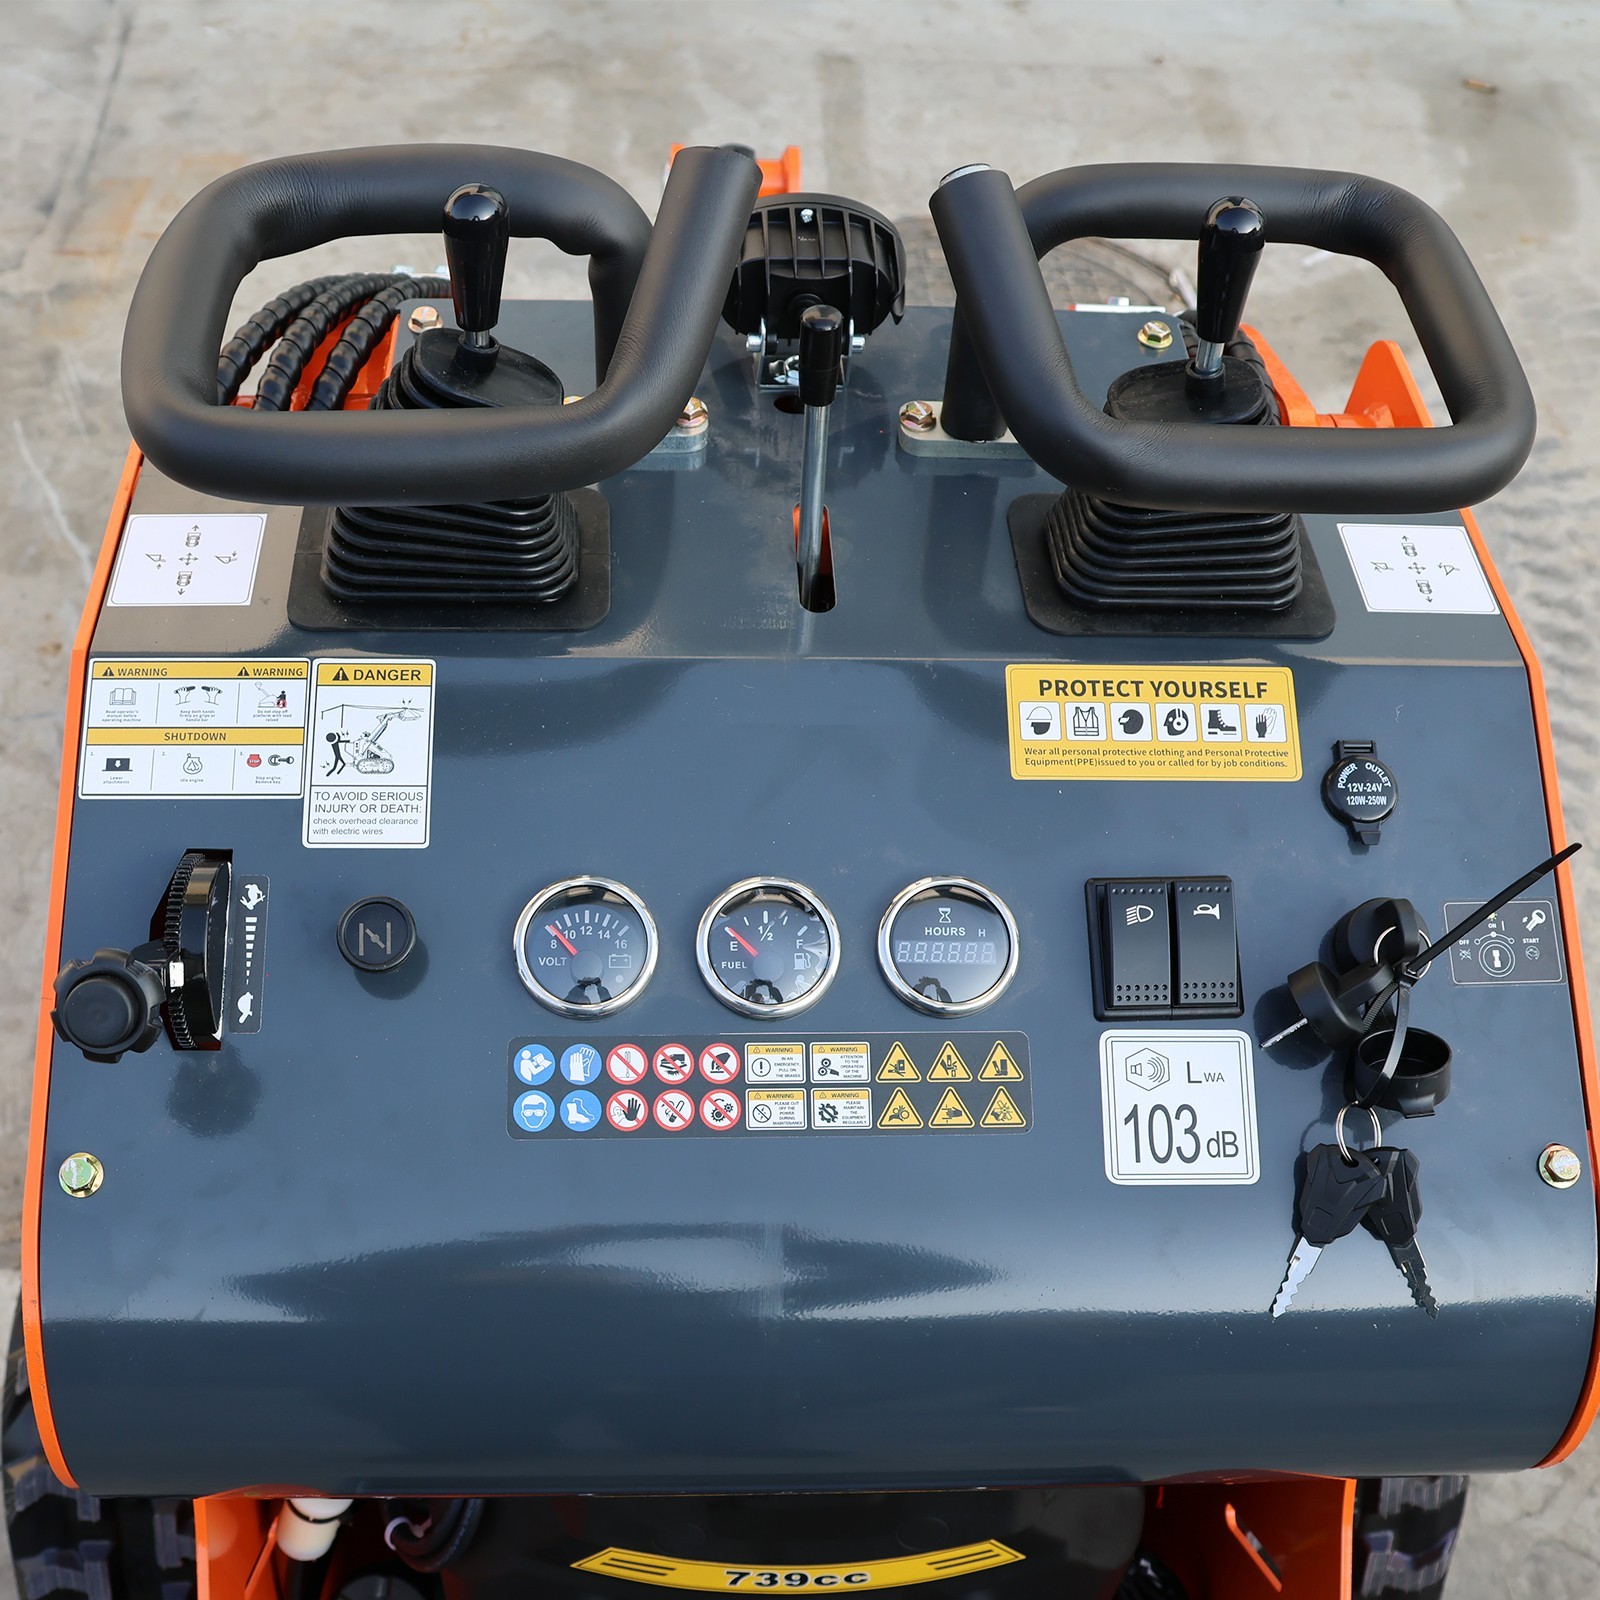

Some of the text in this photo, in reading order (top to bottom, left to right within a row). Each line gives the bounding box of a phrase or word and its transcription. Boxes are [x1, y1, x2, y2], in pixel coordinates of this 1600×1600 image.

[117, 668, 168, 676] WARNING
[252, 668, 303, 676] WARNING
[353, 670, 421, 681] DANGER
[1038, 679, 1268, 698] PROTECT YOURSELF
[164, 732, 226, 741] SHUTDOWN
[1062, 748, 1100, 756] personal
[1103, 748, 1147, 757] protective
[1149, 748, 1184, 758] clothing
[1025, 758, 1125, 766] Equipment(PPE)issued
[1211, 759, 1221, 768] by
[1223, 759, 1237, 768] job
[1239, 759, 1288, 767] conditions.
[1338, 762, 1391, 788] POWER OUTLET
[1347, 782, 1382, 792] 12V-24V
[314, 792, 424, 801] TO AVOID SERIOUS
[1346, 796, 1387, 805] 120W-250W
[314, 804, 422, 813] INJURY OR DEATH:
[925, 926, 966, 936] HOURS
[978, 929, 986, 937] H
[550, 926, 628, 949] 8 10 12 14 16
[730, 942, 738, 951] E
[796, 939, 804, 949] F
[538, 957, 567, 966] VOLT
[1124, 1104, 1239, 1164] 103 dB
[725, 1570, 870, 1587] 739cc
